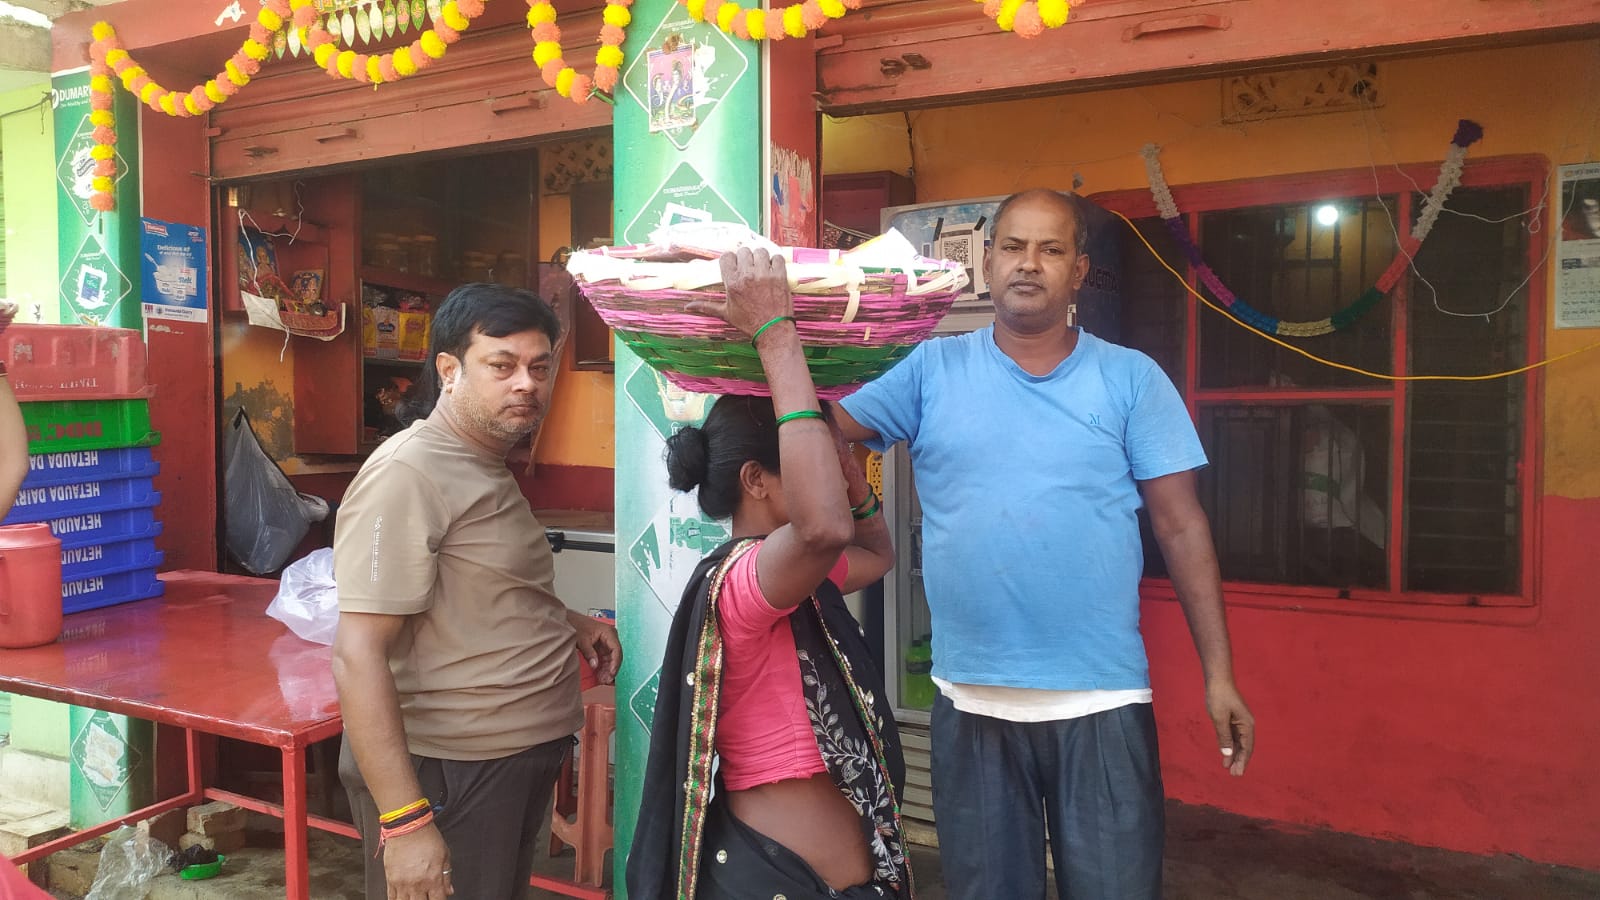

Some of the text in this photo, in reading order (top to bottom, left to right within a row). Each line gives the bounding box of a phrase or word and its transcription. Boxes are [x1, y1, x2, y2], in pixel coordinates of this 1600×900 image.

[46, 421, 102, 441] DDC
[29, 450, 98, 470] HETAUDA DA
[50, 482, 100, 502] HETAUDA
[51, 513, 101, 535] HETAUDA
